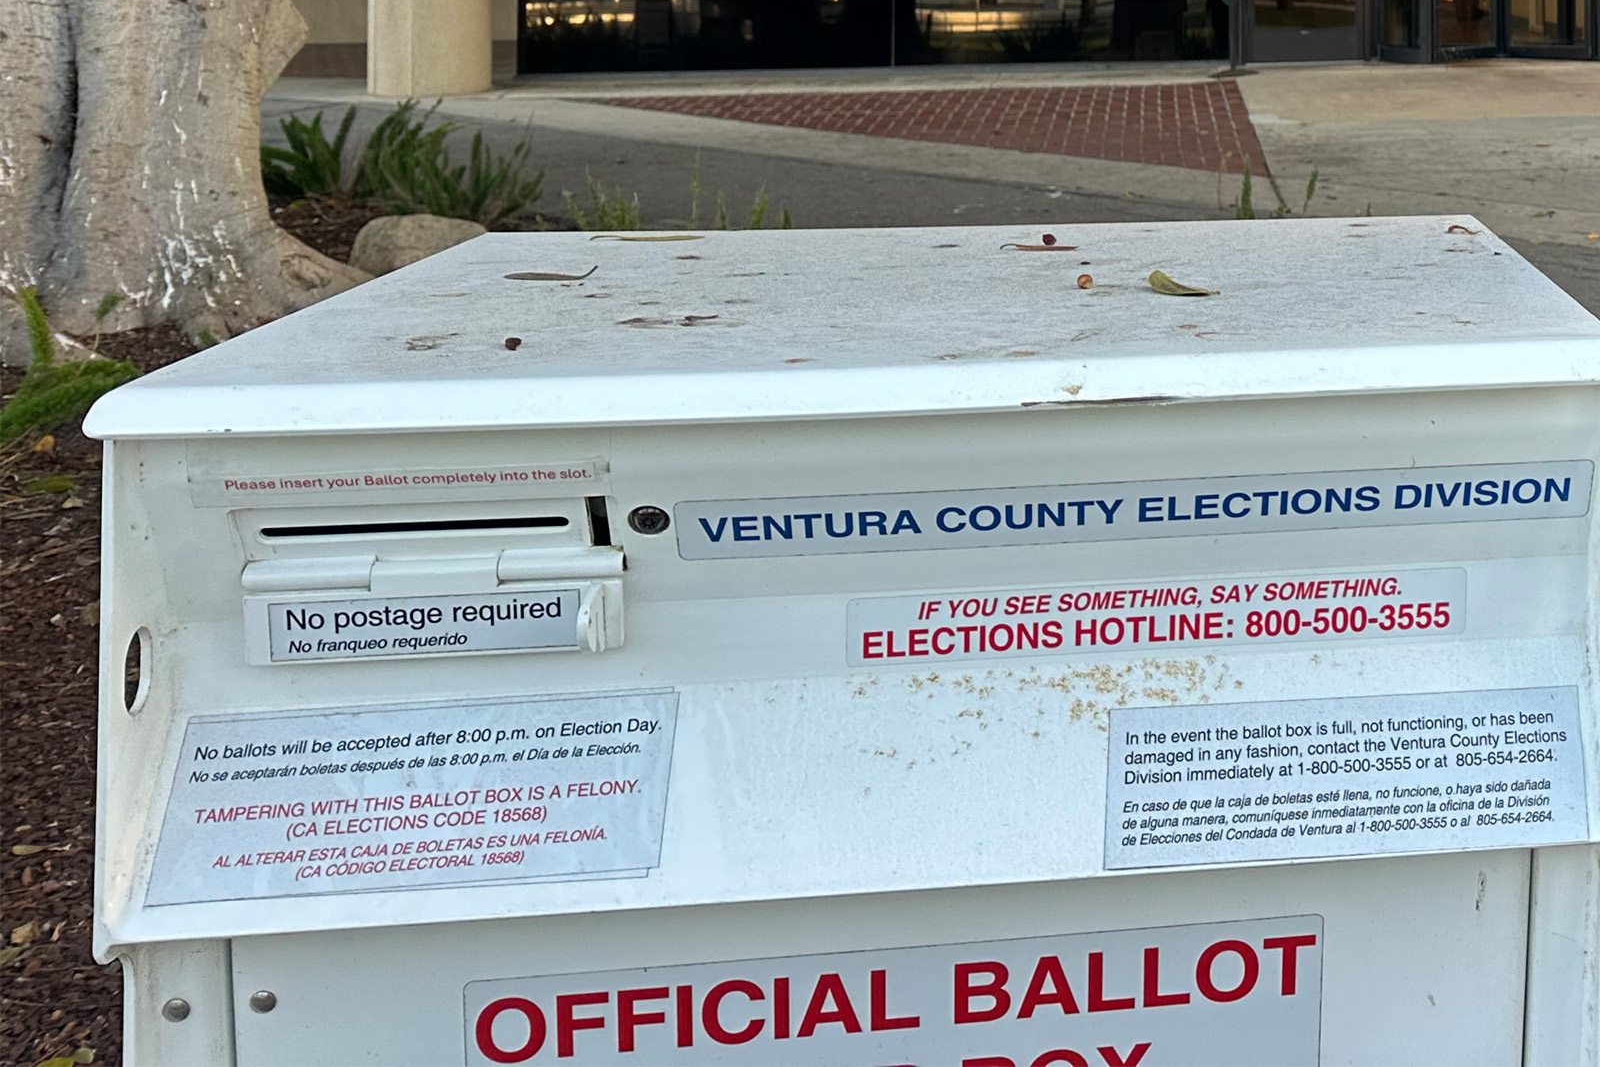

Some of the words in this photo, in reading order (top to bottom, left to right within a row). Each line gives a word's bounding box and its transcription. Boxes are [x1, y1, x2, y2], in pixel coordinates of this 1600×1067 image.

[224, 479, 276, 490] Please
[279, 477, 324, 489] insert
[327, 476, 361, 490] your
[363, 474, 409, 486] Ballot
[412, 471, 496, 485] completely
[499, 470, 529, 481] into
[531, 469, 556, 480] the
[559, 468, 592, 479] slot.
[697, 509, 922, 542] VENTURA
[935, 498, 1124, 533] COUNTY
[1138, 485, 1380, 523] ELECTIONS
[1394, 477, 1571, 510] DIVISION
[286, 608, 325, 631] No
[333, 605, 443, 634] postage
[452, 596, 561, 626] required
[917, 600, 942, 620] IF
[948, 597, 999, 618] YOU
[1003, 594, 1053, 616] SEE
[1057, 586, 1202, 613] SOMETHING,
[1209, 583, 1259, 604] SAY
[1262, 577, 1402, 602] SOMETHING.
[288, 639, 312, 654] No
[316, 638, 388, 653] franqueo
[391, 631, 468, 654] requerido
[862, 620, 1063, 659] ELECTIONS
[1074, 612, 1233, 646] HOTLINE:
[1245, 601, 1450, 638] 800-500-3555
[193, 745, 219, 761] No
[222, 742, 277, 759] ballots
[281, 739, 308, 755] will
[310, 738, 333, 753] be
[336, 732, 412, 753] accepted
[414, 731, 453, 747] after
[455, 727, 492, 744] 8:00
[494, 728, 530, 745] p.m.
[534, 726, 555, 739] on
[559, 720, 622, 737] Election
[626, 718, 662, 735] Day.
[1125, 731, 1139, 745] In
[1143, 730, 1166, 745] the
[1170, 728, 1212, 743] event
[1215, 726, 1238, 741] the
[1242, 724, 1282, 740] ballot
[1285, 723, 1312, 737] box
[1316, 721, 1328, 735] is
[1331, 720, 1356, 735] full,
[1361, 719, 1384, 733] not
[1386, 715, 1467, 732] functioning,
[1471, 716, 1487, 727] or
[1489, 712, 1515, 726] has
[1518, 711, 1554, 725] been
[188, 770, 209, 784] No
[211, 771, 229, 782] se
[230, 764, 297, 782] aceptarán
[298, 762, 348, 776] boletas
[349, 757, 406, 774] después
[407, 756, 425, 769] de
[427, 755, 447, 767] las
[449, 752, 479, 766] 8:00
[478, 752, 508, 767] p.m.
[511, 749, 526, 762] el
[526, 747, 550, 761] Día
[551, 746, 569, 759] de
[570, 745, 583, 758] la
[585, 741, 641, 757] Elección.
[1124, 747, 1194, 767] damaged
[1198, 747, 1211, 761] in
[1215, 748, 1242, 763] any
[1245, 743, 1303, 759] fashion,
[1307, 739, 1360, 756] contact
[1363, 738, 1386, 752] the
[1389, 736, 1446, 751] Ventura
[1449, 732, 1500, 749] County
[1504, 729, 1567, 745] Elections
[1124, 768, 1182, 785] Division
[1186, 763, 1275, 781] immediately
[1278, 762, 1293, 777] at
[1297, 756, 1412, 775] 1-800-500-3555
[1415, 757, 1431, 769] or
[1434, 754, 1448, 768] at
[1455, 748, 1557, 767] 805-654-2664.
[194, 801, 305, 824] TAMPERING
[310, 798, 359, 816] WITH
[362, 794, 405, 812] THIS
[409, 789, 481, 809] BALLOT
[483, 786, 524, 804] BOX
[527, 785, 545, 801] IS
[548, 784, 561, 799] A
[566, 778, 641, 798] FELONY.
[1122, 800, 1139, 813] En
[1141, 801, 1170, 812] caso
[1172, 798, 1188, 811] de
[1189, 799, 1212, 812] que
[1214, 795, 1225, 808] la
[1227, 793, 1252, 810] caja
[1254, 793, 1270, 806] de
[1271, 792, 1313, 805] boletas
[1315, 789, 1340, 803] esté
[1342, 789, 1372, 801] llena,
[1375, 789, 1390, 799] no
[1392, 785, 1442, 798] funcione,
[1455, 782, 1482, 797] haya
[1484, 780, 1508, 793] sido
[1510, 778, 1551, 792] dañada
[286, 821, 318, 842] (CA
[323, 813, 429, 835] ELECTIONS
[433, 809, 487, 828] CODE
[492, 805, 547, 824] 18568)
[211, 854, 231, 869] AL
[307, 846, 347, 862] ESTA
[346, 843, 388, 861] CAJA
[391, 841, 415, 856] DE
[415, 836, 485, 854] BOLETAS
[486, 834, 508, 848] ES
[509, 832, 540, 847] UNA
[543, 825, 607, 844] FELONÍA.
[294, 864, 321, 882] (CA
[324, 860, 387, 877] CÓDIGO
[388, 854, 475, 872] ELECTORAL
[481, 850, 525, 865] 18568)
[474, 969, 920, 1066] OFFICIAL
[952, 934, 1317, 1025] BALLOT
